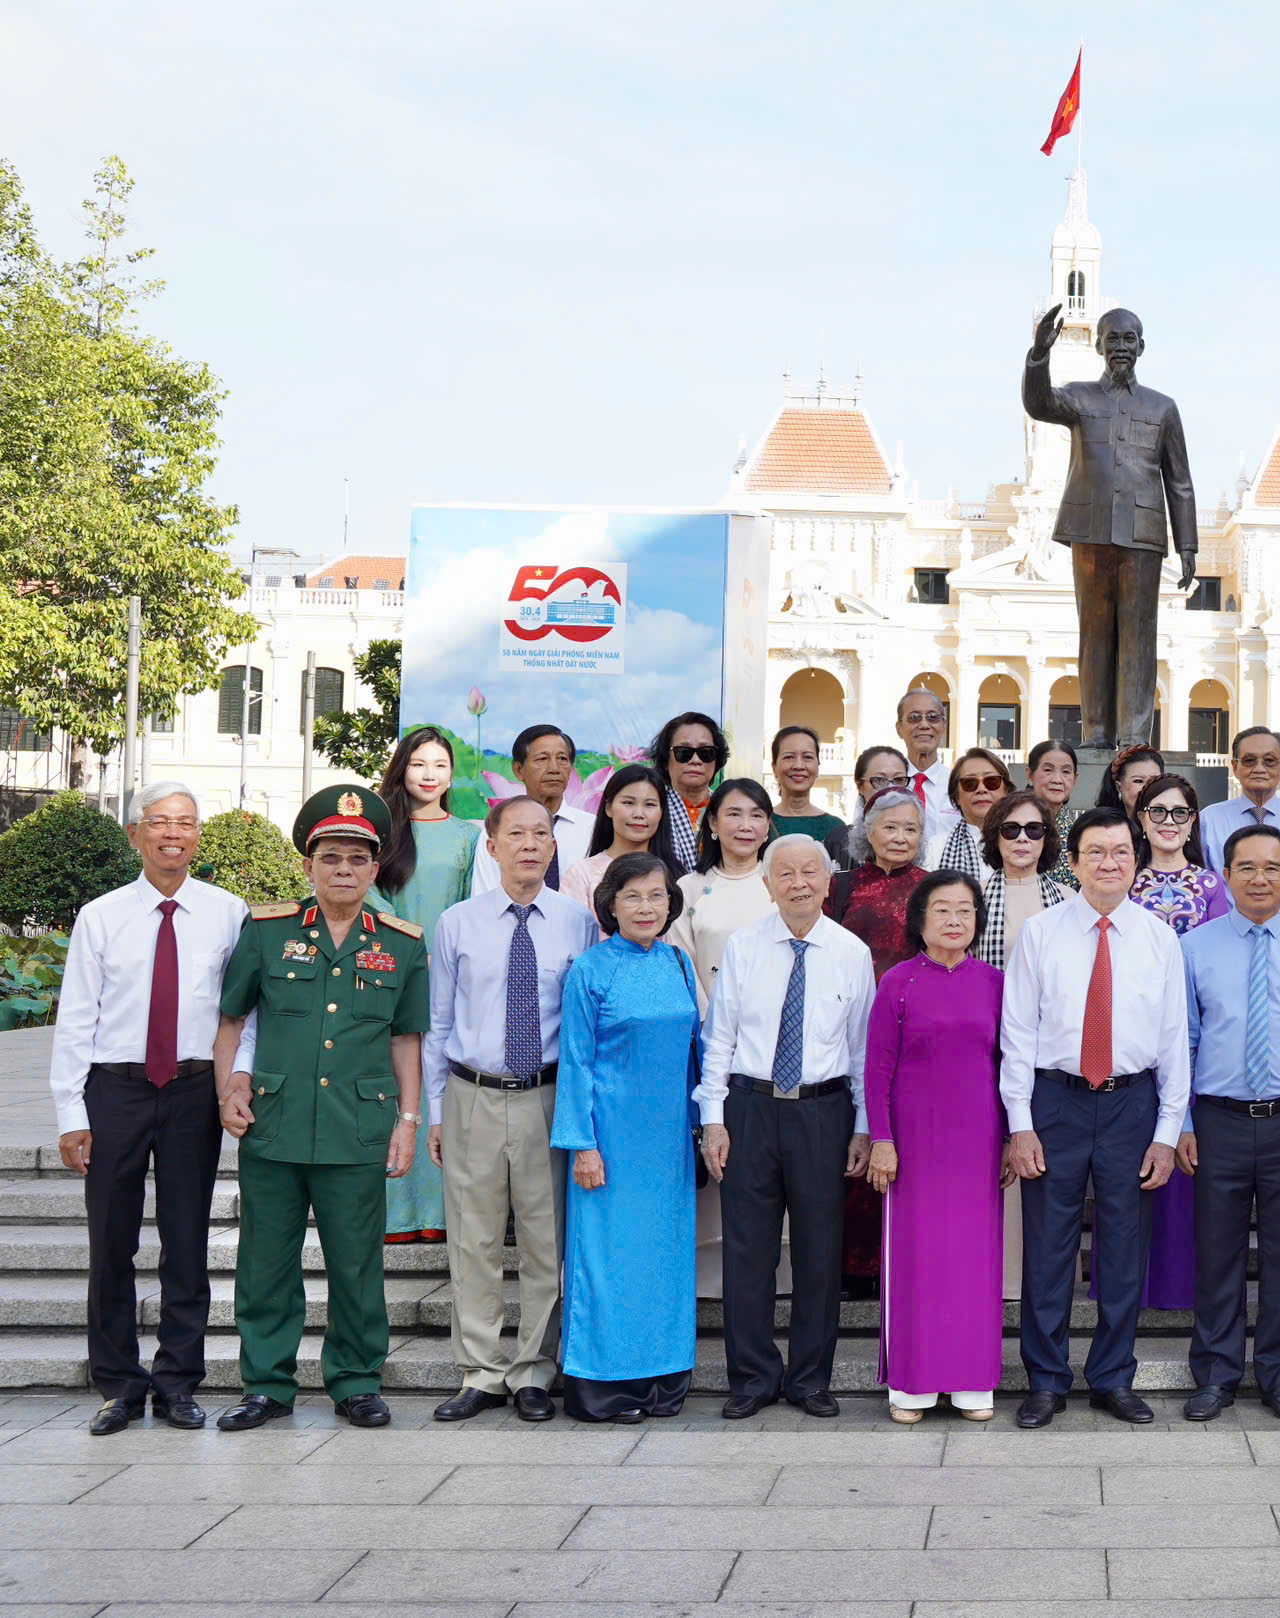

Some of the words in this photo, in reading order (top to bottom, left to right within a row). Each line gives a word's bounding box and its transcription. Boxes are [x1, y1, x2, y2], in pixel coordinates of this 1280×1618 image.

[520, 606, 541, 616] 30.4
[502, 649, 510, 657] 50
[604, 651, 620, 660] NAM
